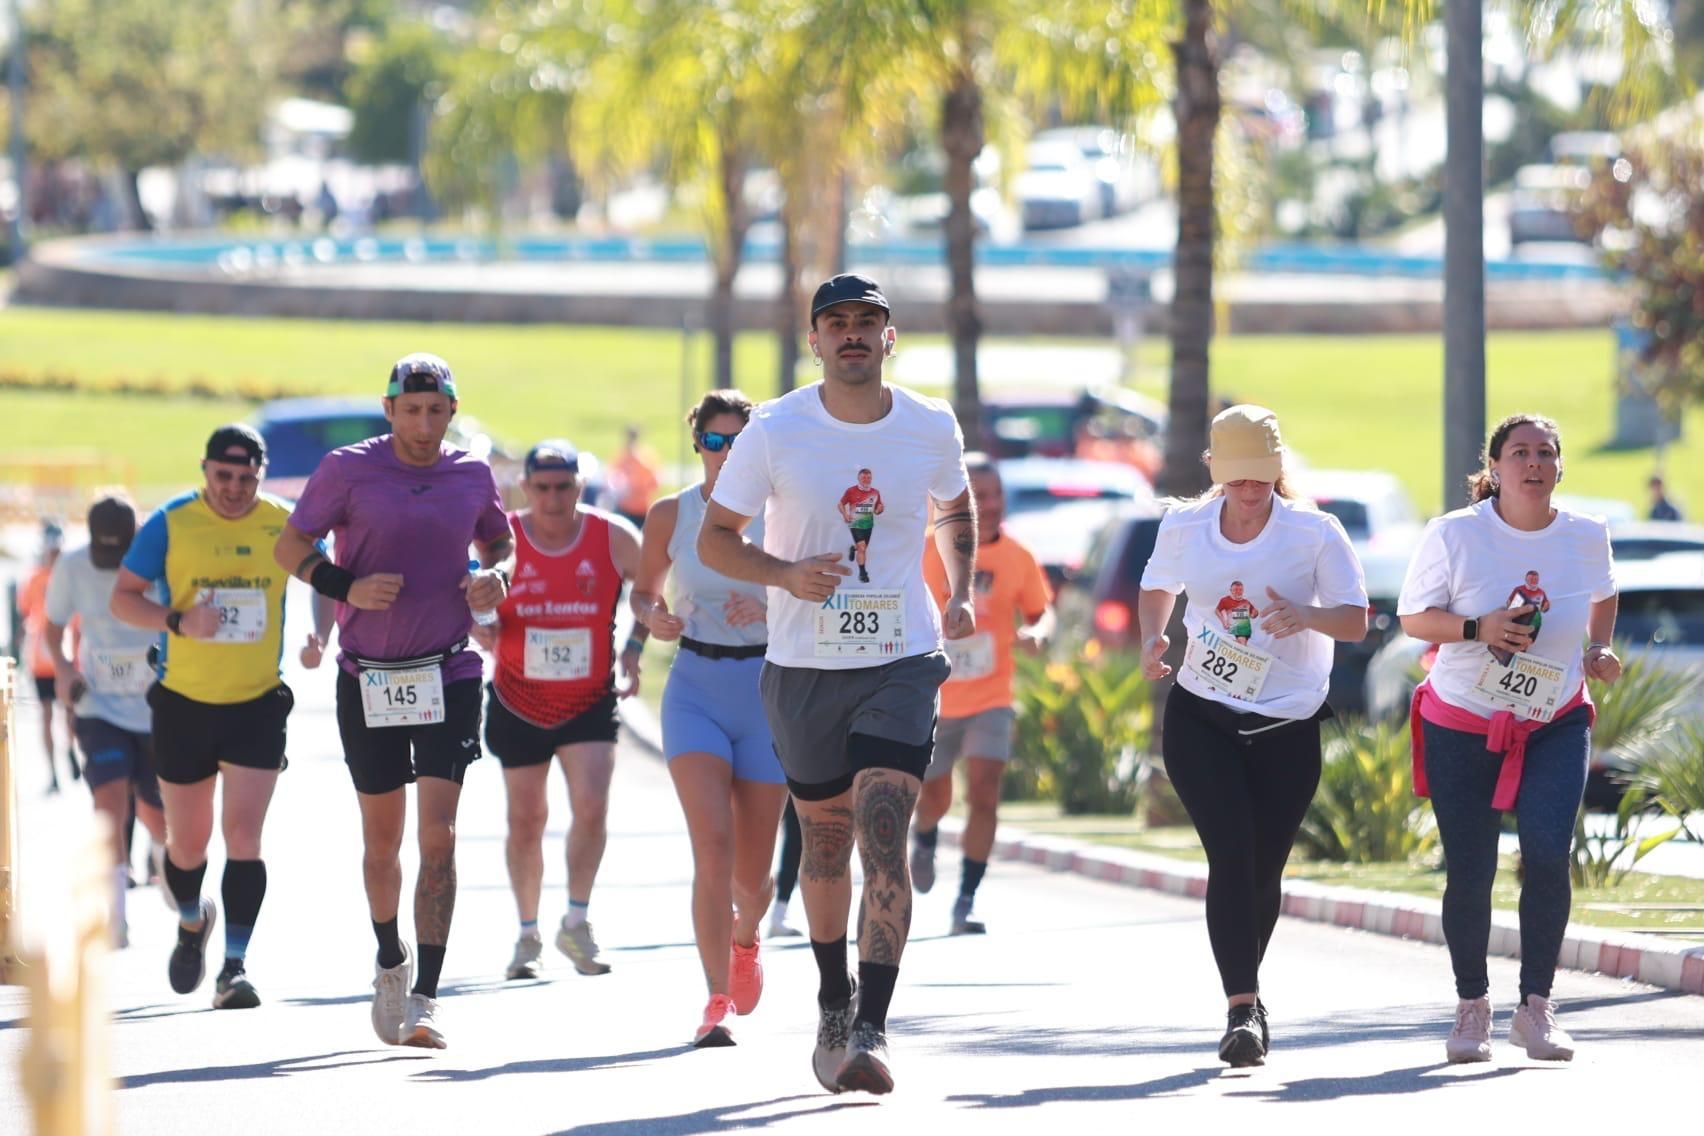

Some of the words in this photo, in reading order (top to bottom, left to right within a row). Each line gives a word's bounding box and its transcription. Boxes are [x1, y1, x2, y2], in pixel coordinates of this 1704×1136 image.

[822, 593, 848, 610] XII
[848, 599, 898, 611] TOMARES
[840, 611, 879, 634] 283
[542, 645, 571, 664] 152
[1197, 625, 1220, 650] XII
[1217, 644, 1264, 673] TOMARES
[1201, 649, 1239, 684] 282
[1516, 660, 1561, 682] TOMARES
[366, 671, 389, 687] XII
[390, 672, 434, 686] TOMARES
[1499, 670, 1538, 698] 420
[383, 685, 417, 706] 145
